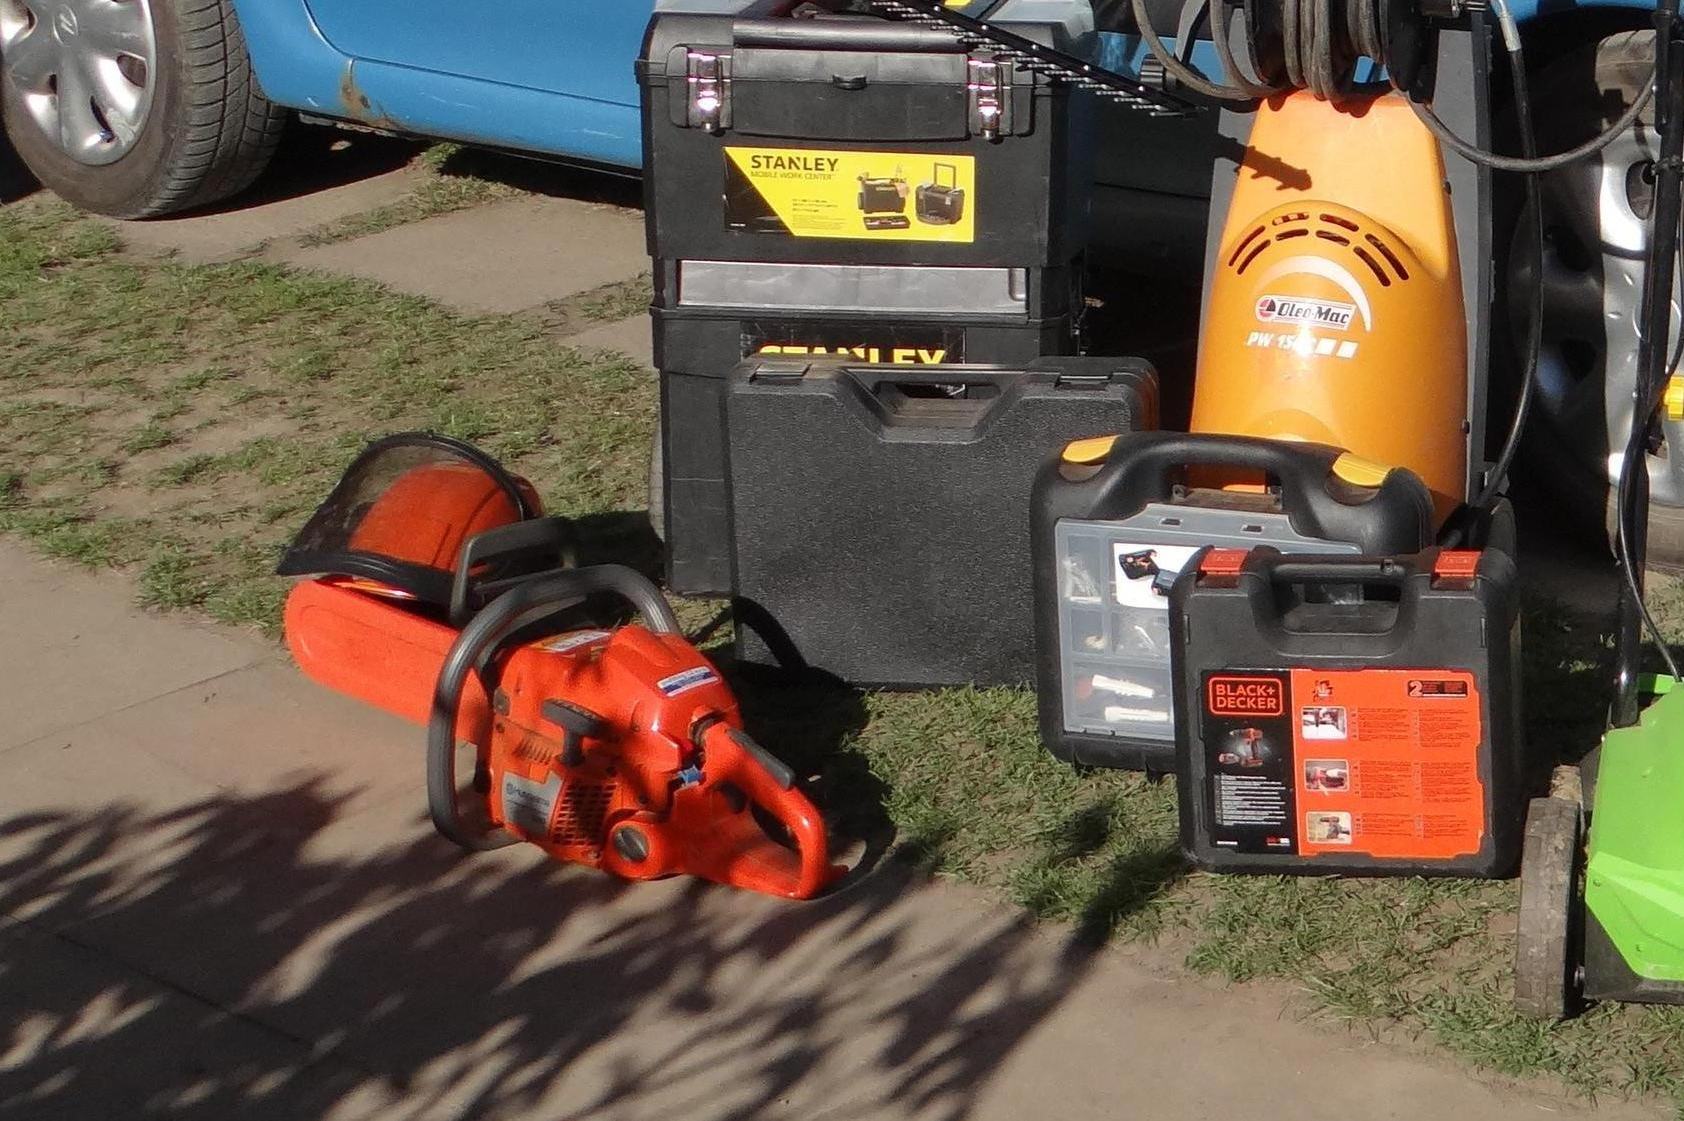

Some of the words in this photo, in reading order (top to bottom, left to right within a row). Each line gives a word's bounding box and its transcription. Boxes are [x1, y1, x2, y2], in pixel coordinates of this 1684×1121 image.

[751, 154, 839, 172] STANLEY
[1246, 331, 1274, 348] PW
[1215, 683, 1276, 696] BLACK+
[1216, 697, 1277, 710] DECKER
